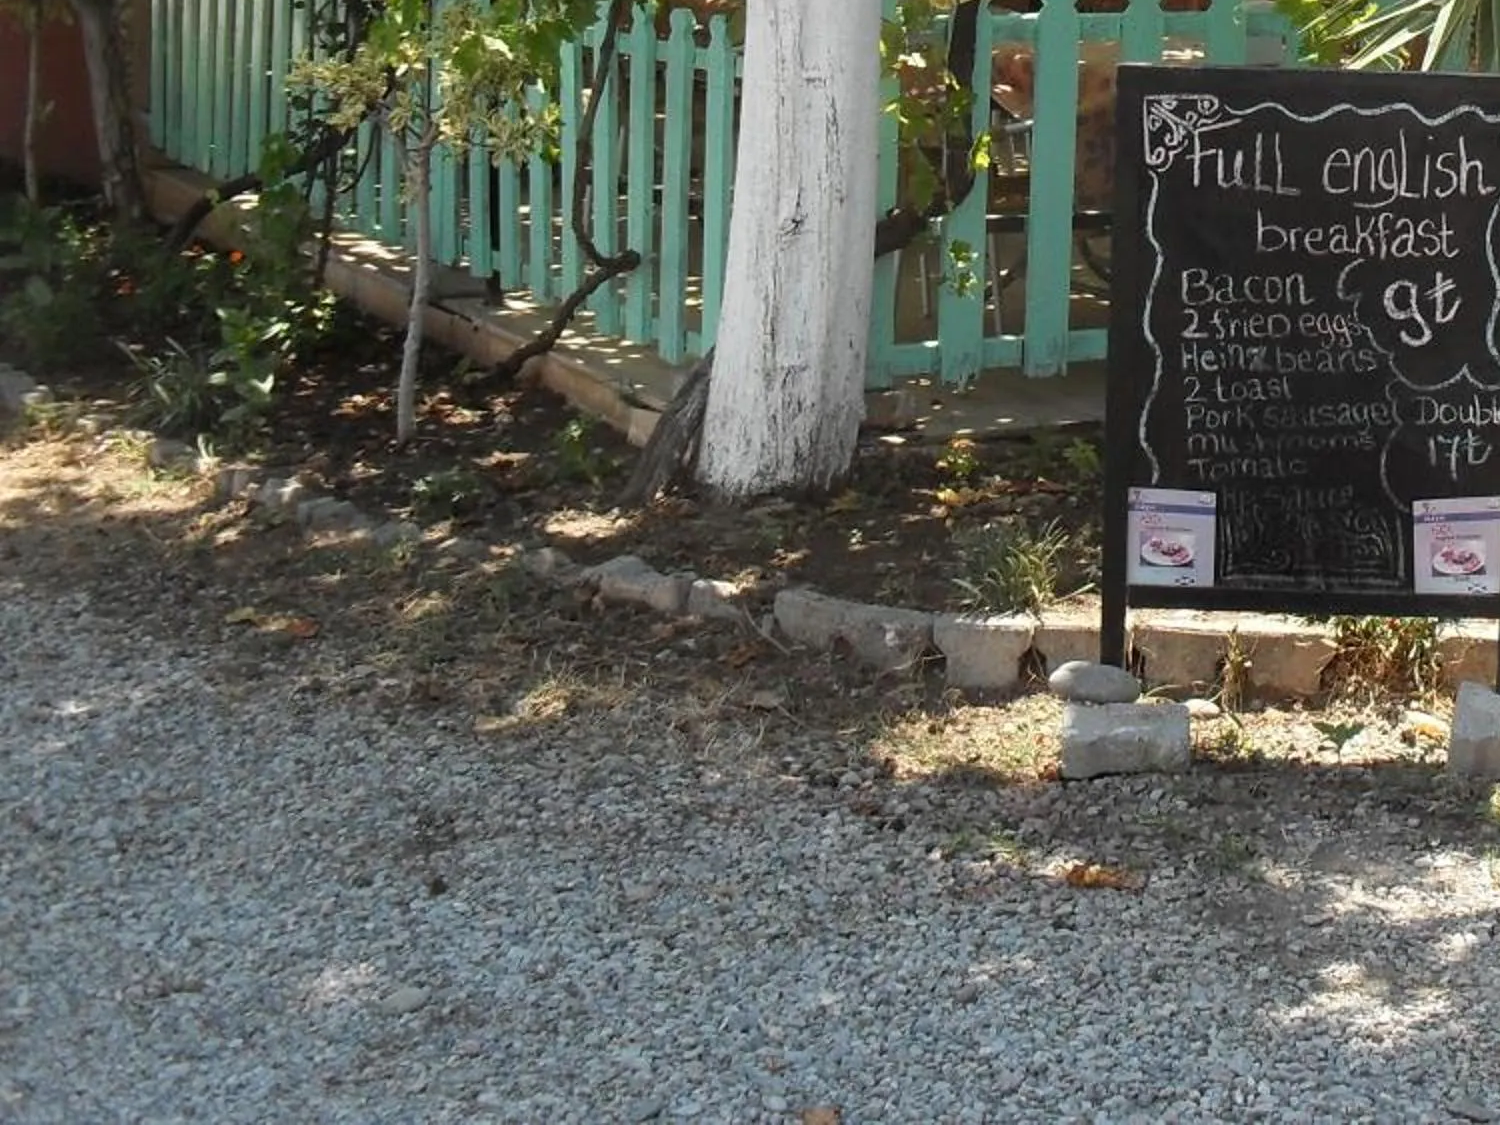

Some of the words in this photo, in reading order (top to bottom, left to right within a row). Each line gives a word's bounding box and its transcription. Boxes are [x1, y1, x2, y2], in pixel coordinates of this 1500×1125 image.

[1181, 268, 1315, 305] Bacon
[1182, 308, 1209, 338] 2
[1299, 312, 1362, 348] eggs
[1276, 345, 1378, 374] beans
[1183, 376, 1208, 402] 2
